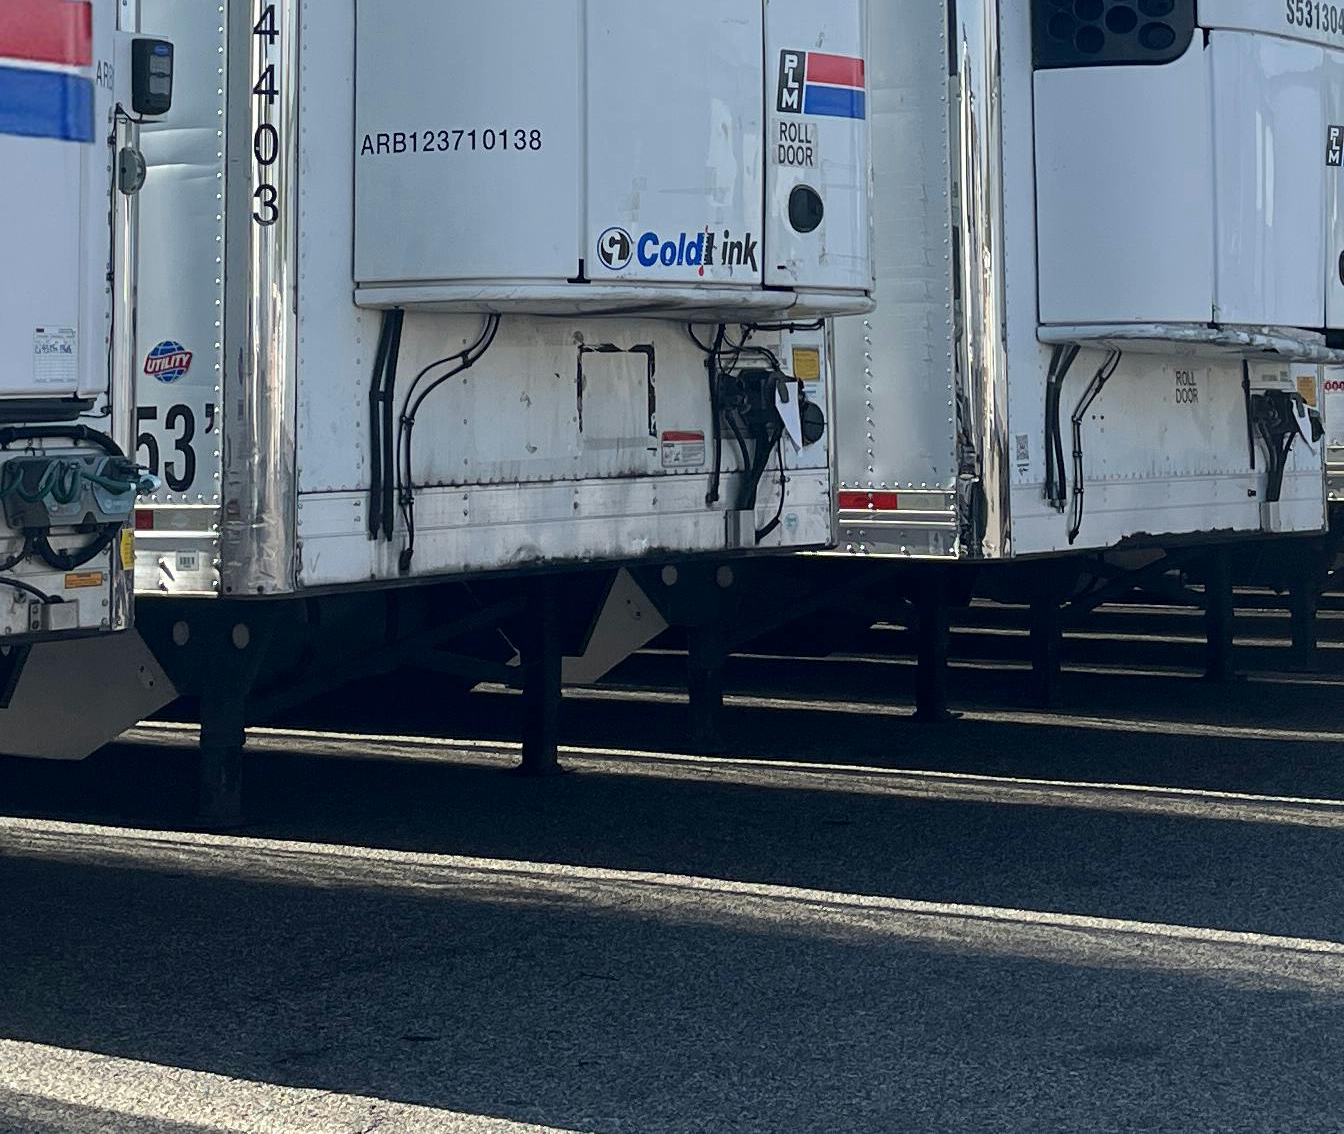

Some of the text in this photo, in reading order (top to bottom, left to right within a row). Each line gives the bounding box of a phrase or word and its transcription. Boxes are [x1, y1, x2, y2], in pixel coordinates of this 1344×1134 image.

[781, 54, 799, 110] PLM
[361, 129, 542, 156] ARB123710138
[779, 121, 812, 144] ROLL
[778, 144, 813, 166] DOOR
[1328, 127, 1340, 164] PLM
[146, 353, 191, 373] UTILITY
[1176, 371, 1197, 386] ROLL
[1176, 388, 1199, 404] DOOR
